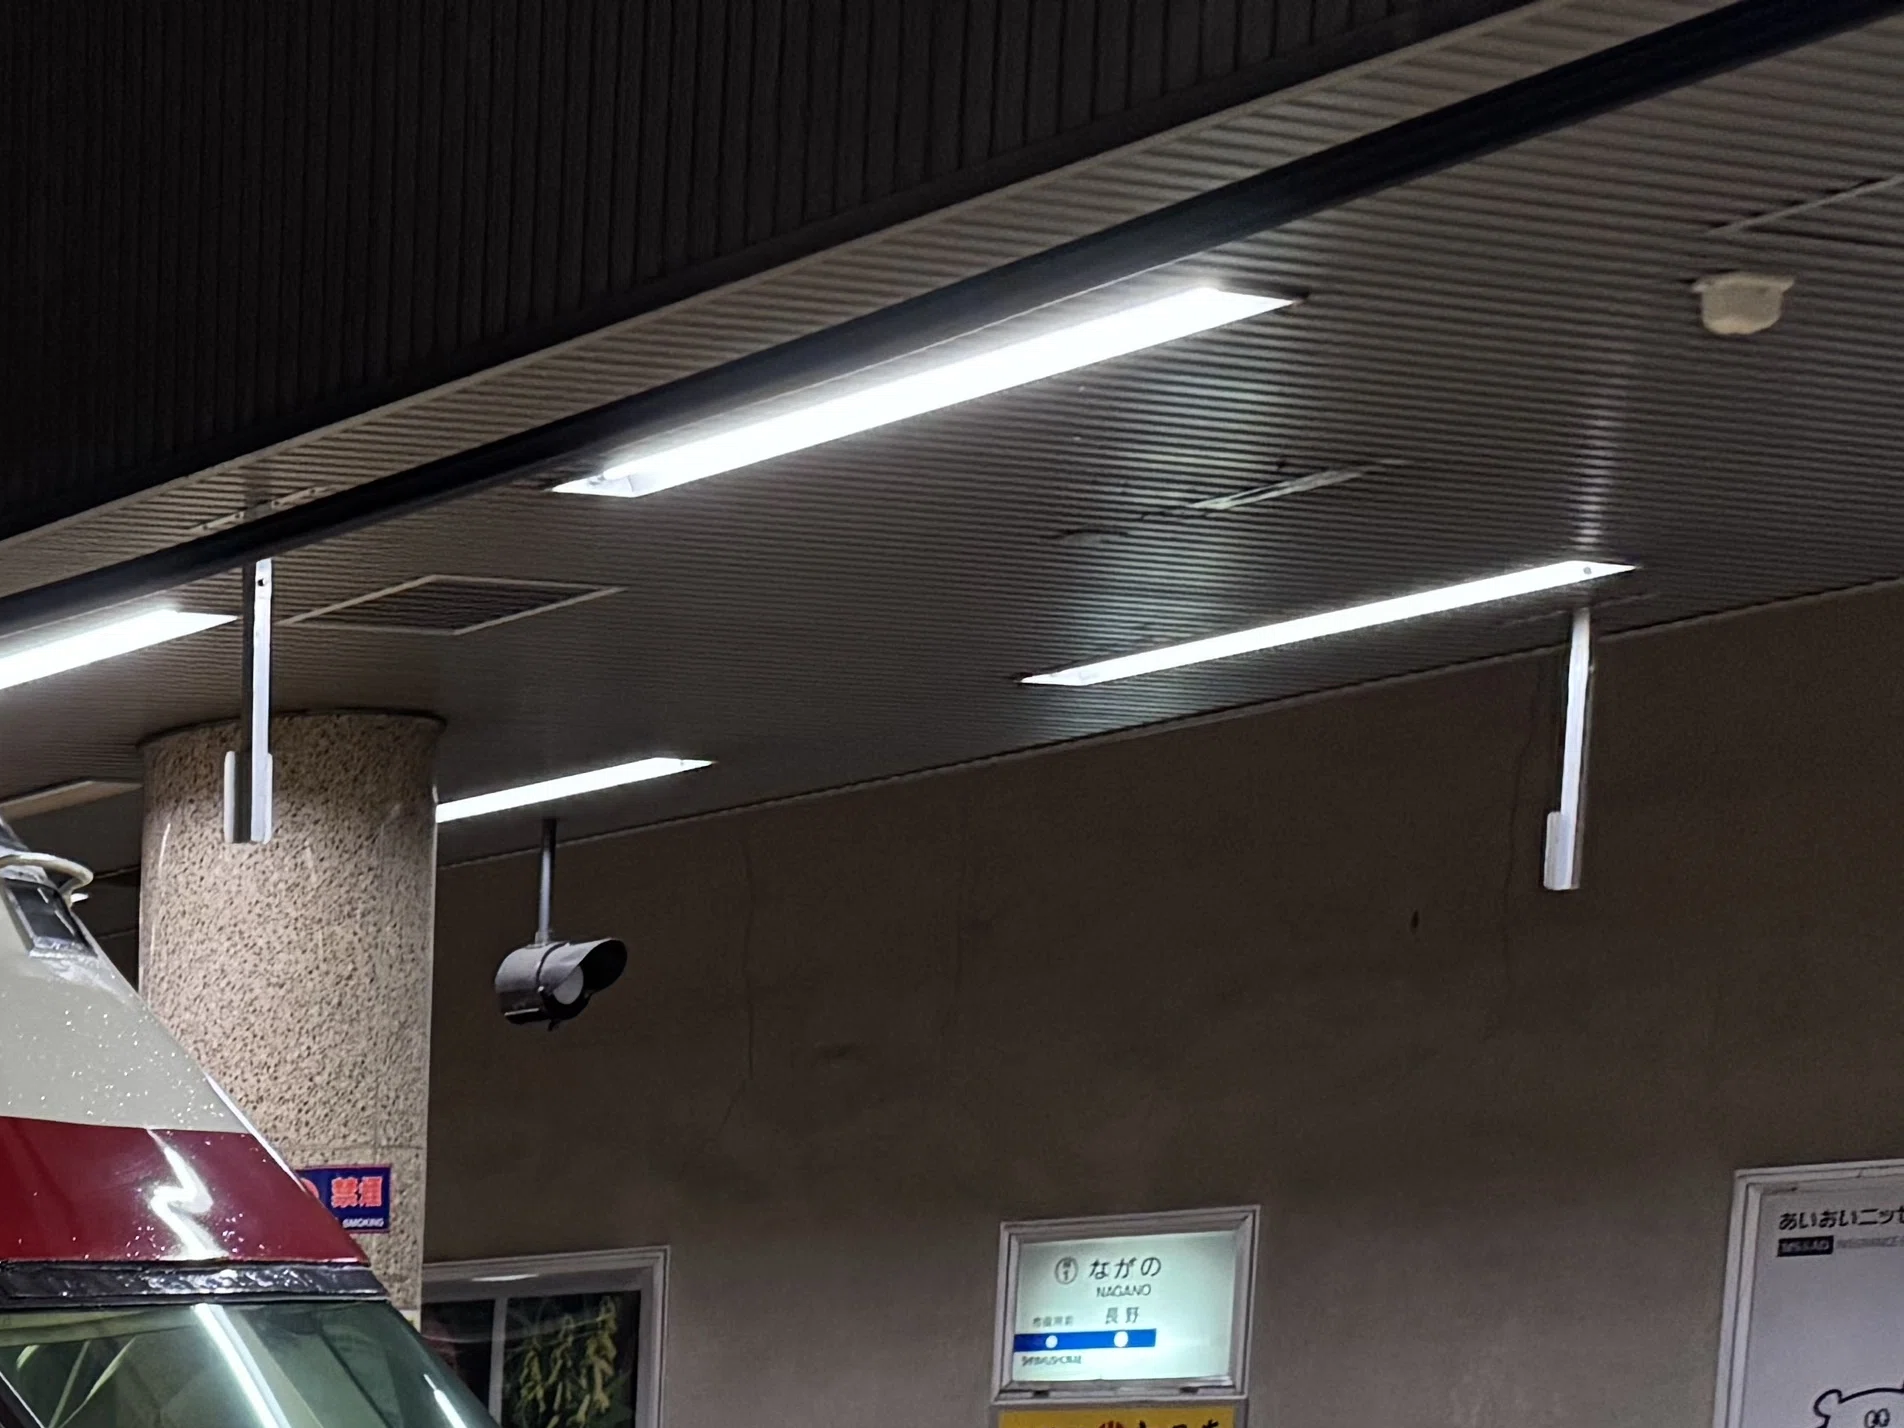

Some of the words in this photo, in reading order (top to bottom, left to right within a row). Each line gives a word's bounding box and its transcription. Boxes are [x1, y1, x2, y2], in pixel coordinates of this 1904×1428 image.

[1089, 1256, 1161, 1280] ながの
[1096, 1283, 1152, 1298] NAGANO
[1104, 1306, 1140, 1325] 長野
